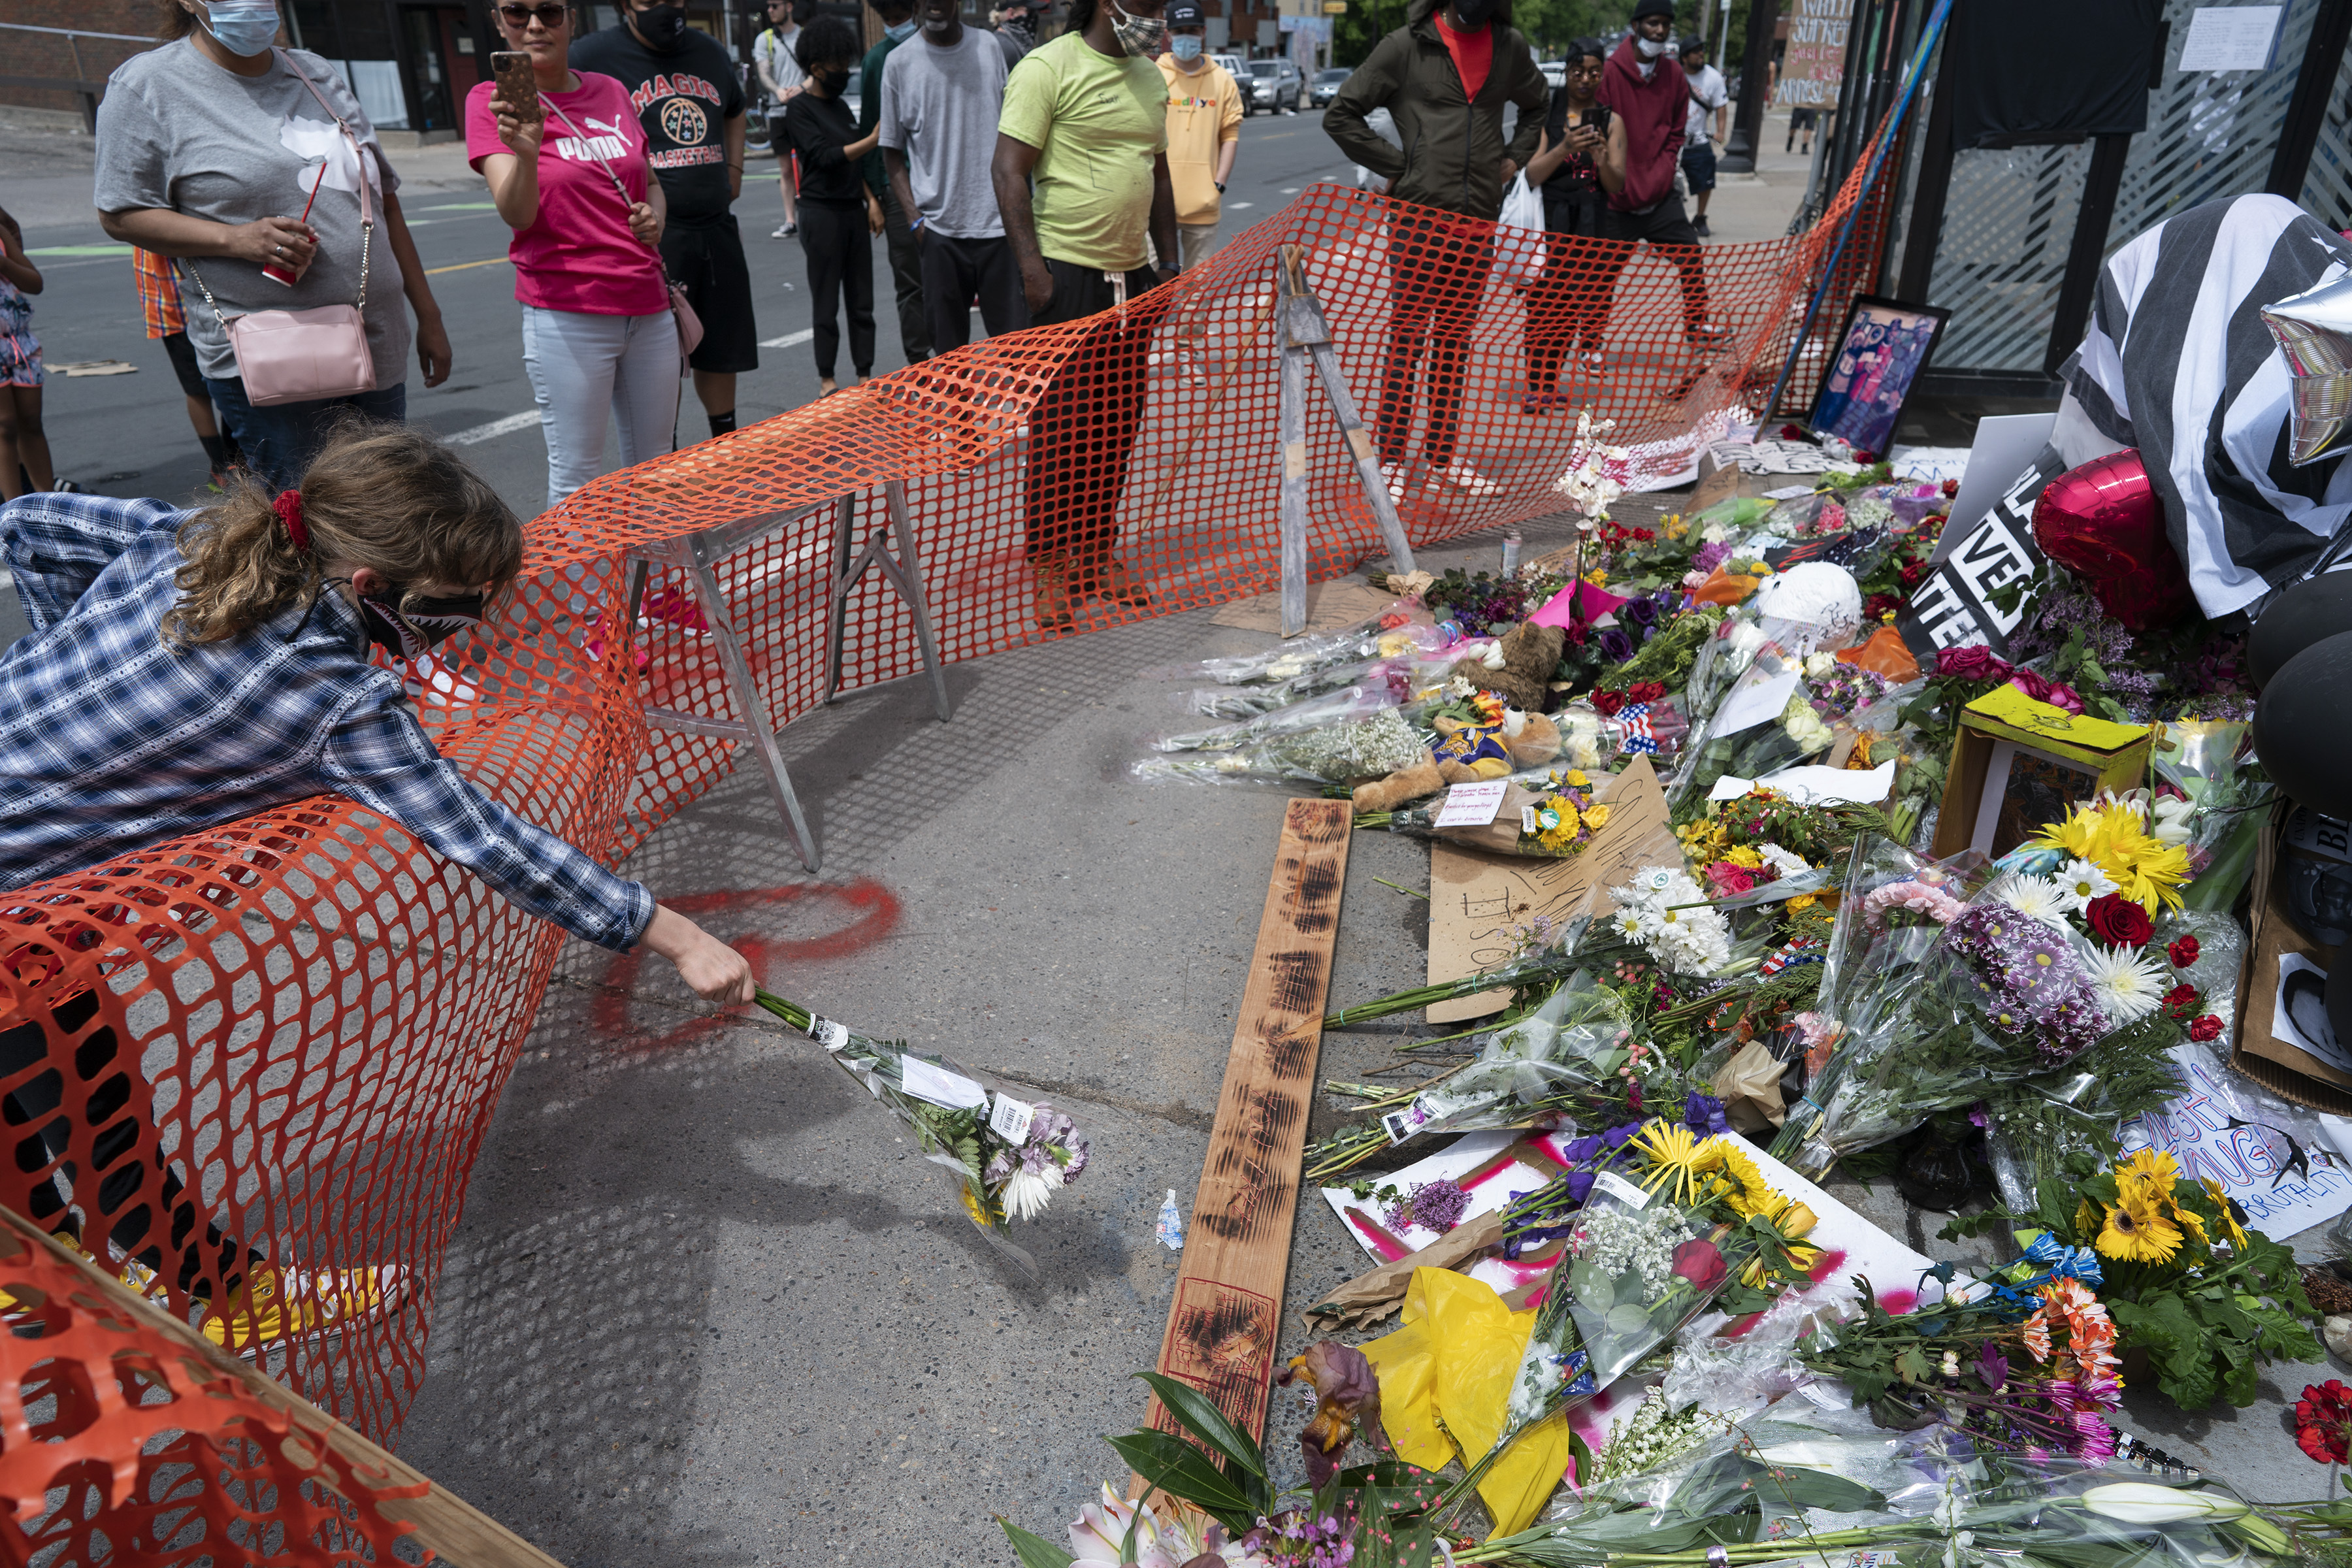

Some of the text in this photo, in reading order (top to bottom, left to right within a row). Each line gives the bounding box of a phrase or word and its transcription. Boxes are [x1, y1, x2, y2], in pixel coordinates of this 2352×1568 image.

[630, 73, 721, 118] MAGIC
[1809, 62, 1845, 82] GEOR
[555, 135, 627, 161] PUMA
[2002, 463, 2042, 535] BLA
[1955, 518, 2034, 614] IVES
[1247, 1088, 1284, 1149] YOU
[1232, 1154, 1268, 1231] FREE
[2237, 1170, 2352, 1220] BRUTALITY
[1211, 1290, 1239, 1378] ABRAHAM
[1232, 1292, 1269, 1431] ROSA PARK
